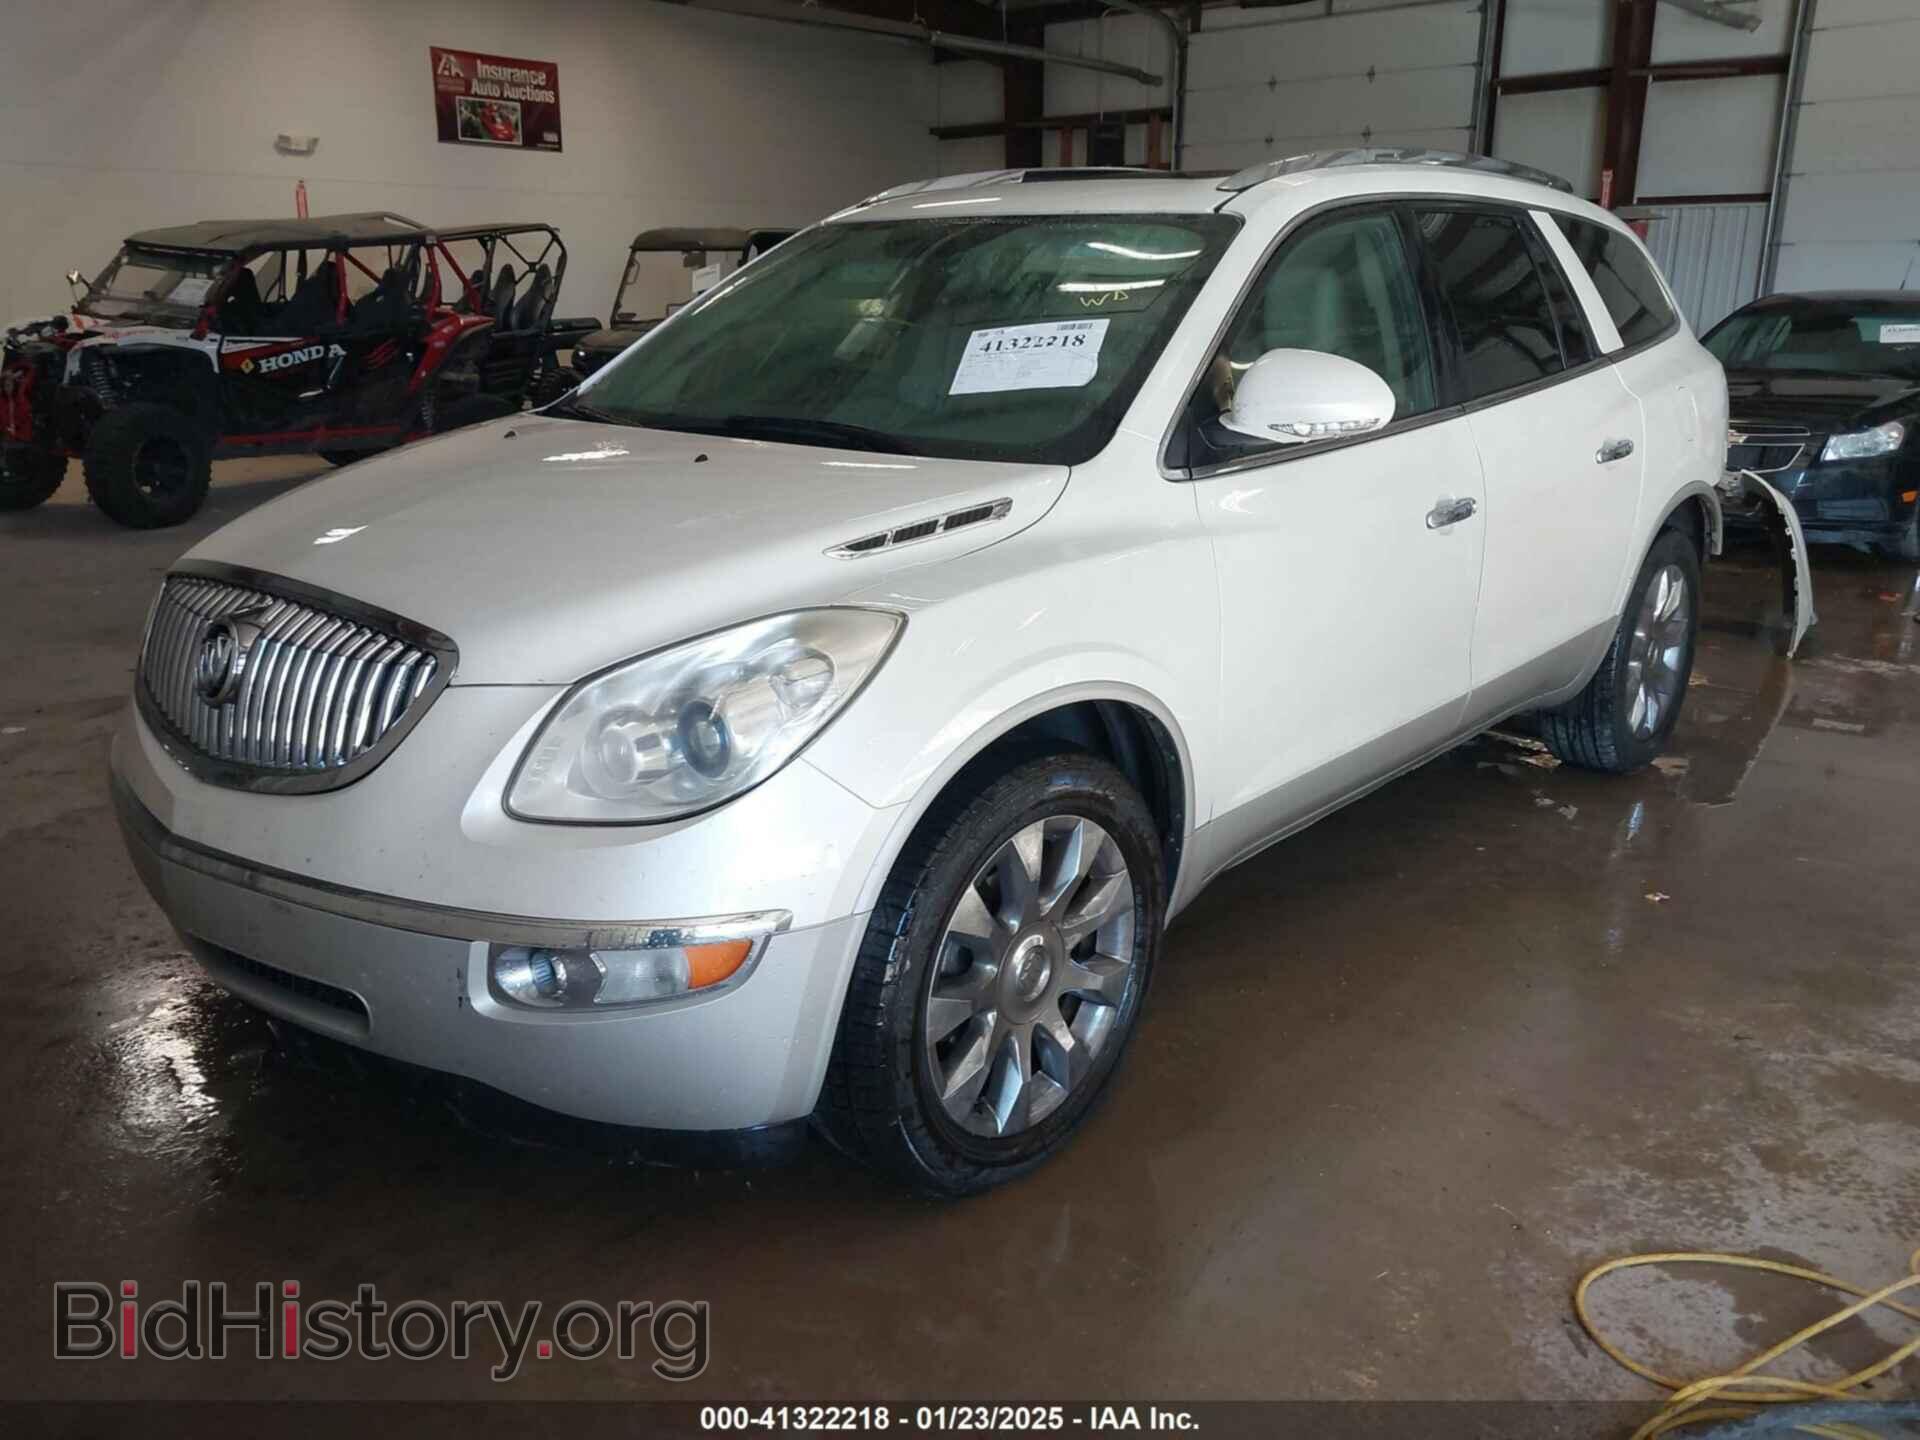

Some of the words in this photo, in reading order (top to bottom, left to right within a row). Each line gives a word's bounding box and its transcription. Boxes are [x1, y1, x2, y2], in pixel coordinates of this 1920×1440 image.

[476, 59, 546, 85] Insurance
[471, 78, 500, 96] Auto
[503, 82, 555, 103] Auctions
[978, 333, 1087, 353] 41322218
[258, 343, 347, 374] HONDA
